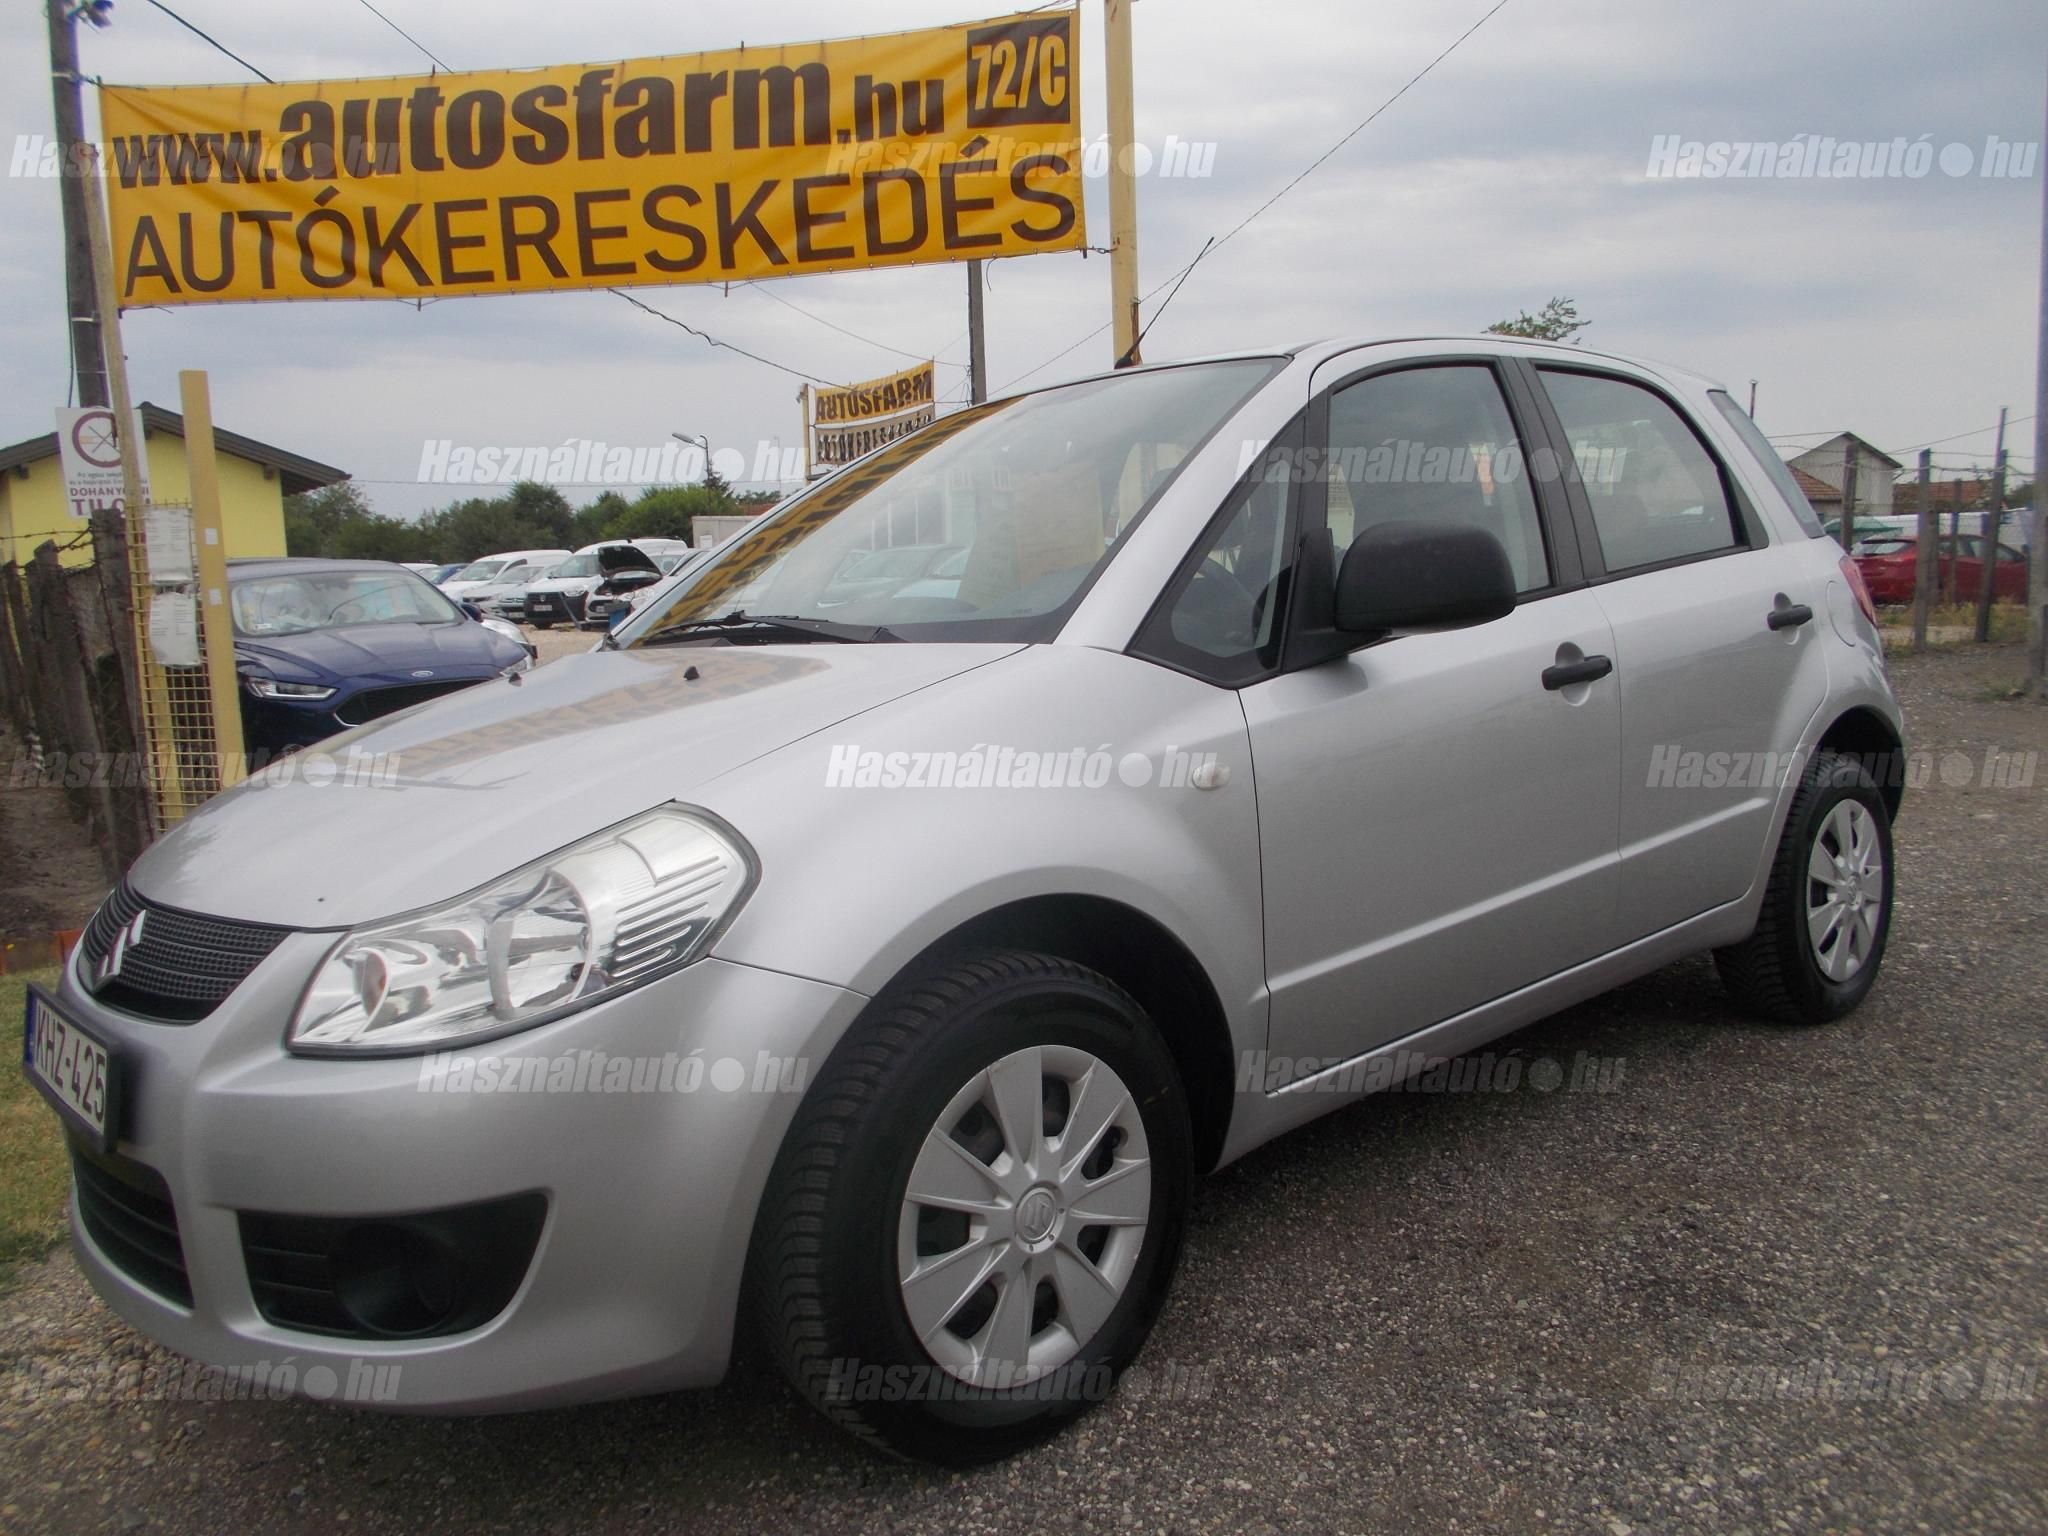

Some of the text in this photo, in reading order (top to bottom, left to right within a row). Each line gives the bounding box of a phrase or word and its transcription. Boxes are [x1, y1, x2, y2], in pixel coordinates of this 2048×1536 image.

[112, 59, 945, 188] www.autosfarm.hu
[970, 35, 1066, 110] 72/C
[124, 134, 1076, 297] AUTÓKERESKEDÉS
[35, 1003, 106, 1122] KHZ-425
